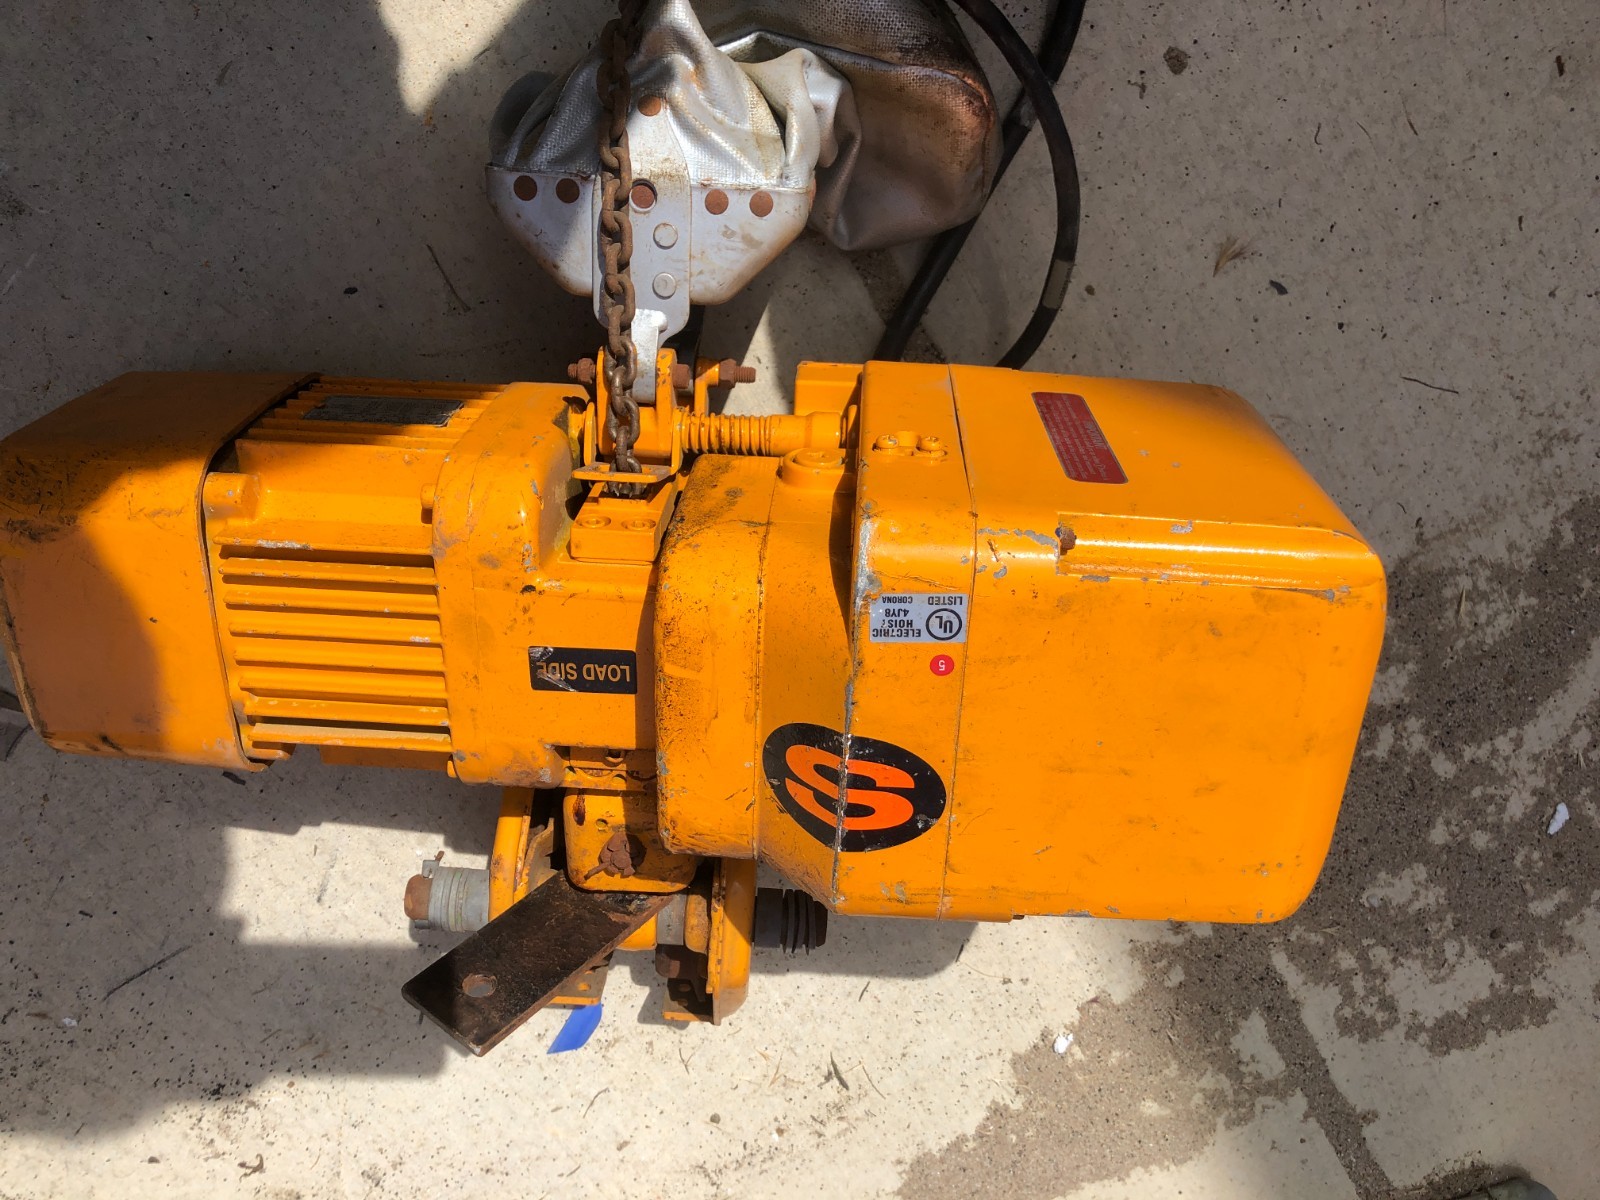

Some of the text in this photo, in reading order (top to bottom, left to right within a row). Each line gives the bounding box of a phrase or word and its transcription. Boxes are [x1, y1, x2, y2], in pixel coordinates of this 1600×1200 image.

[881, 596, 913, 604] CORONA
[927, 595, 963, 606] LISTED
[884, 608, 910, 617] 4JY8
[934, 615, 954, 634] UL
[872, 628, 922, 638] ELECTRIC
[938, 660, 946, 671] 5
[536, 661, 630, 682] LOAD SIDE
